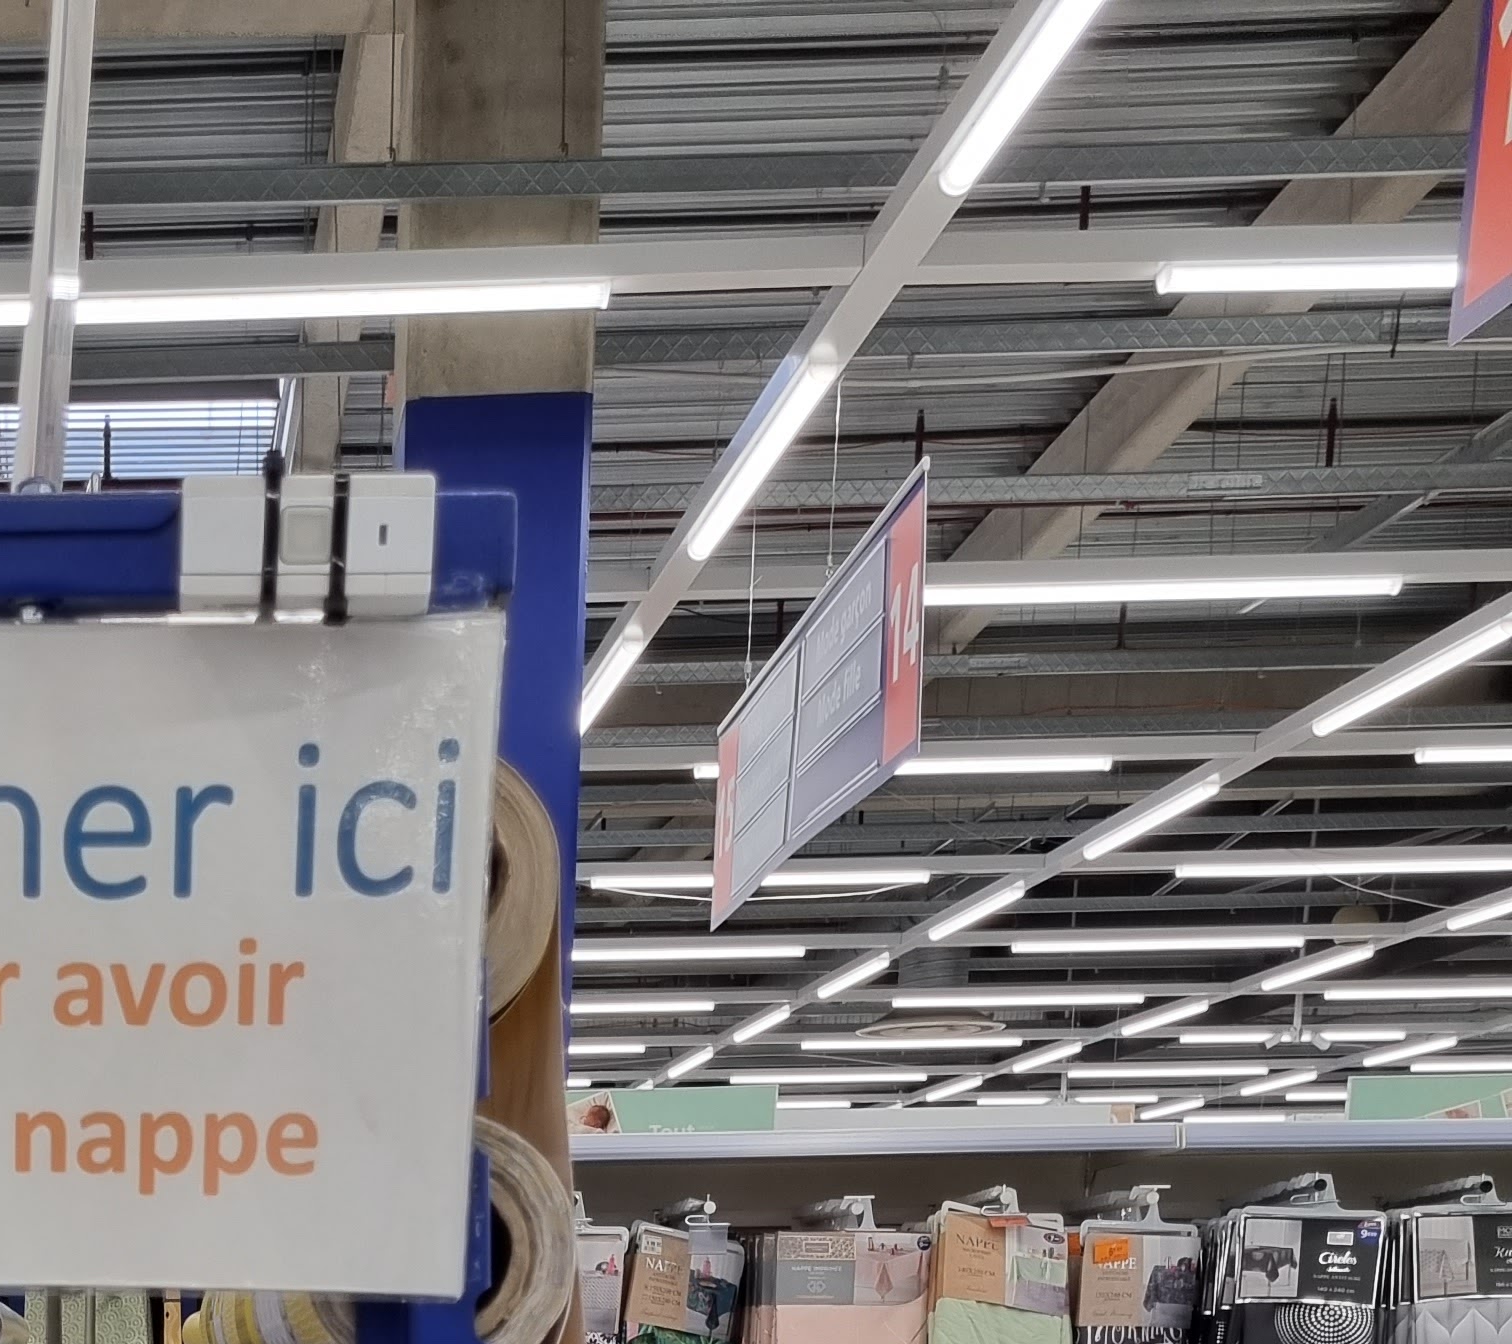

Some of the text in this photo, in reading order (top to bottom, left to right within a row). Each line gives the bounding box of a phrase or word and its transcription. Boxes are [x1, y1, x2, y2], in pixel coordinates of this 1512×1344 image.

[815, 612, 840, 660] Mode
[890, 562, 919, 683] 14
[816, 659, 862, 728] Mode fille
[294, 737, 461, 899] ici
[52, 938, 305, 1028] avoir
[14, 1107, 319, 1196] nappe
[1318, 1251, 1358, 1266] Circles
